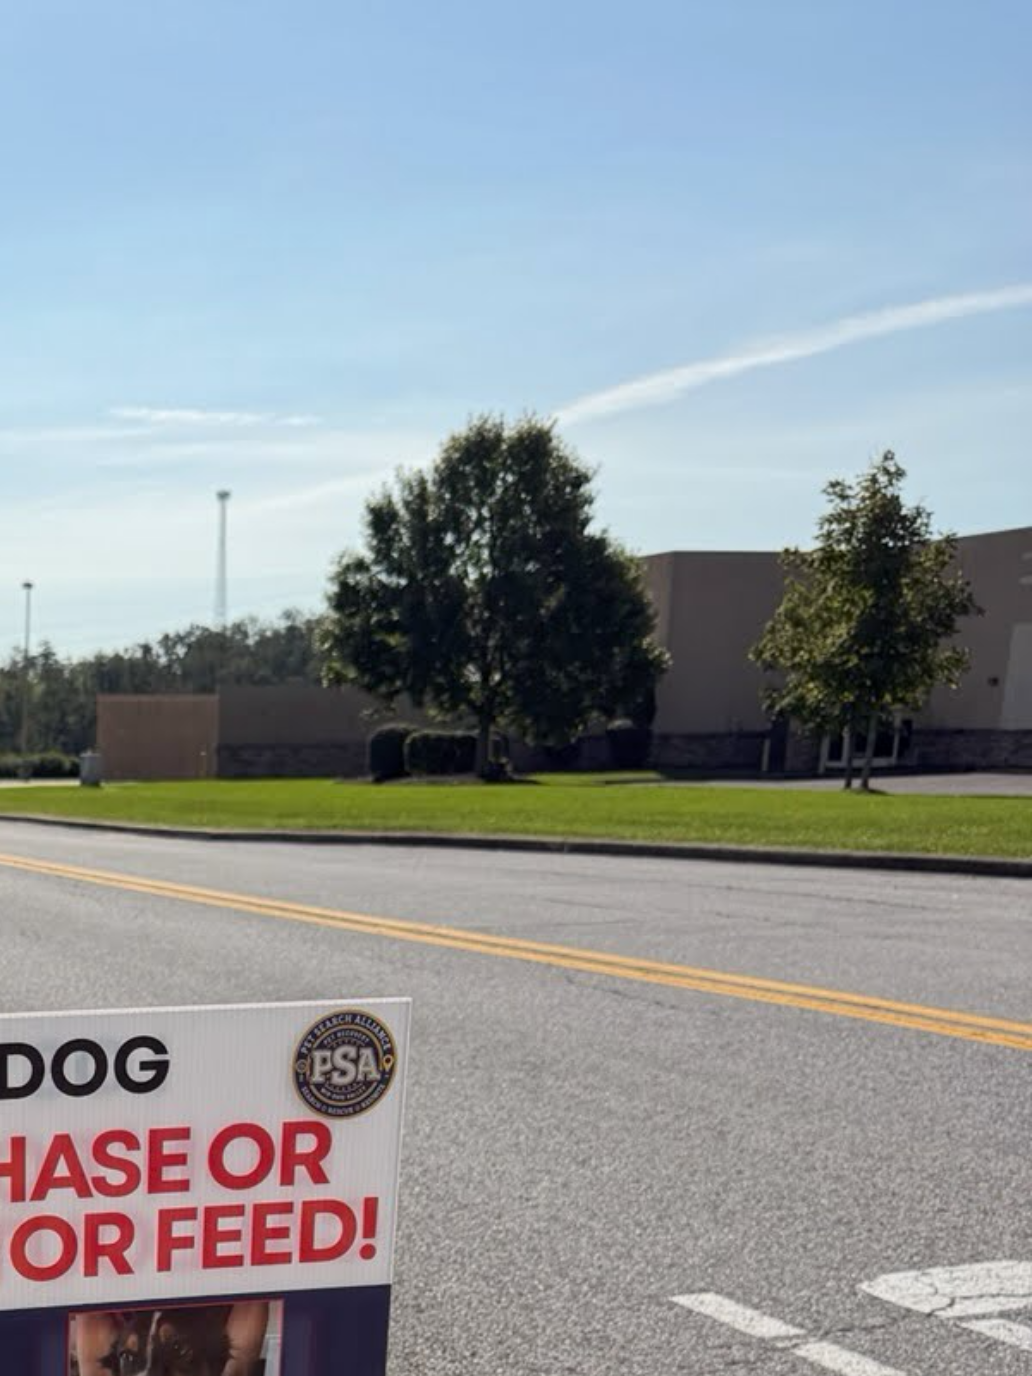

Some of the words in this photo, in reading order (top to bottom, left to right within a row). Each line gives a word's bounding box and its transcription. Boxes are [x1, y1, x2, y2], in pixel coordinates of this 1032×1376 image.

[301, 1035, 315, 1054] PET
[315, 1014, 352, 1036] SEARCH
[354, 1014, 391, 1050] ALLIANCE
[311, 1044, 381, 1087] PSA
[207, 1121, 332, 1190] OR
[10, 1212, 135, 1282] OR
[156, 1197, 379, 1272] FEED!
